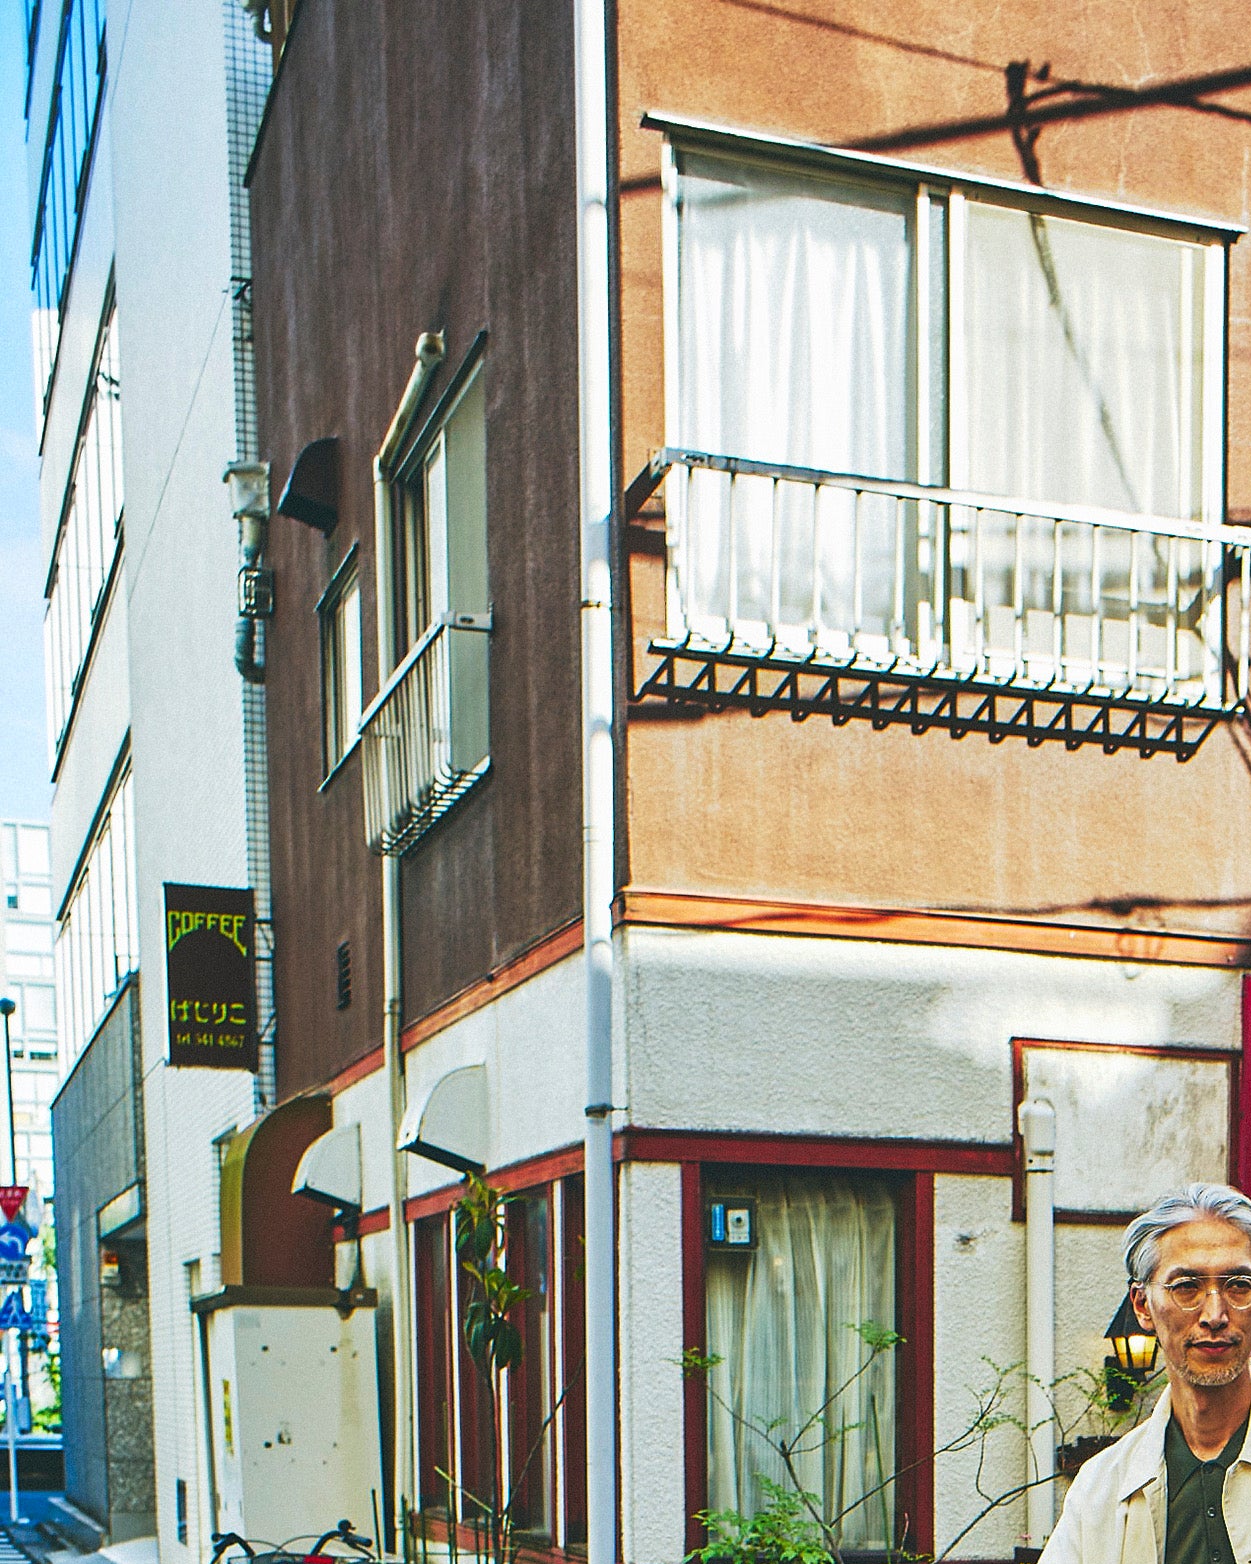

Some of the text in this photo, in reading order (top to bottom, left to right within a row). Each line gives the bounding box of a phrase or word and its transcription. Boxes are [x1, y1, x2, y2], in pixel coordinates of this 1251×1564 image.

[168, 910, 247, 957] COFFEE
[170, 998, 247, 1025] ばじりこ
